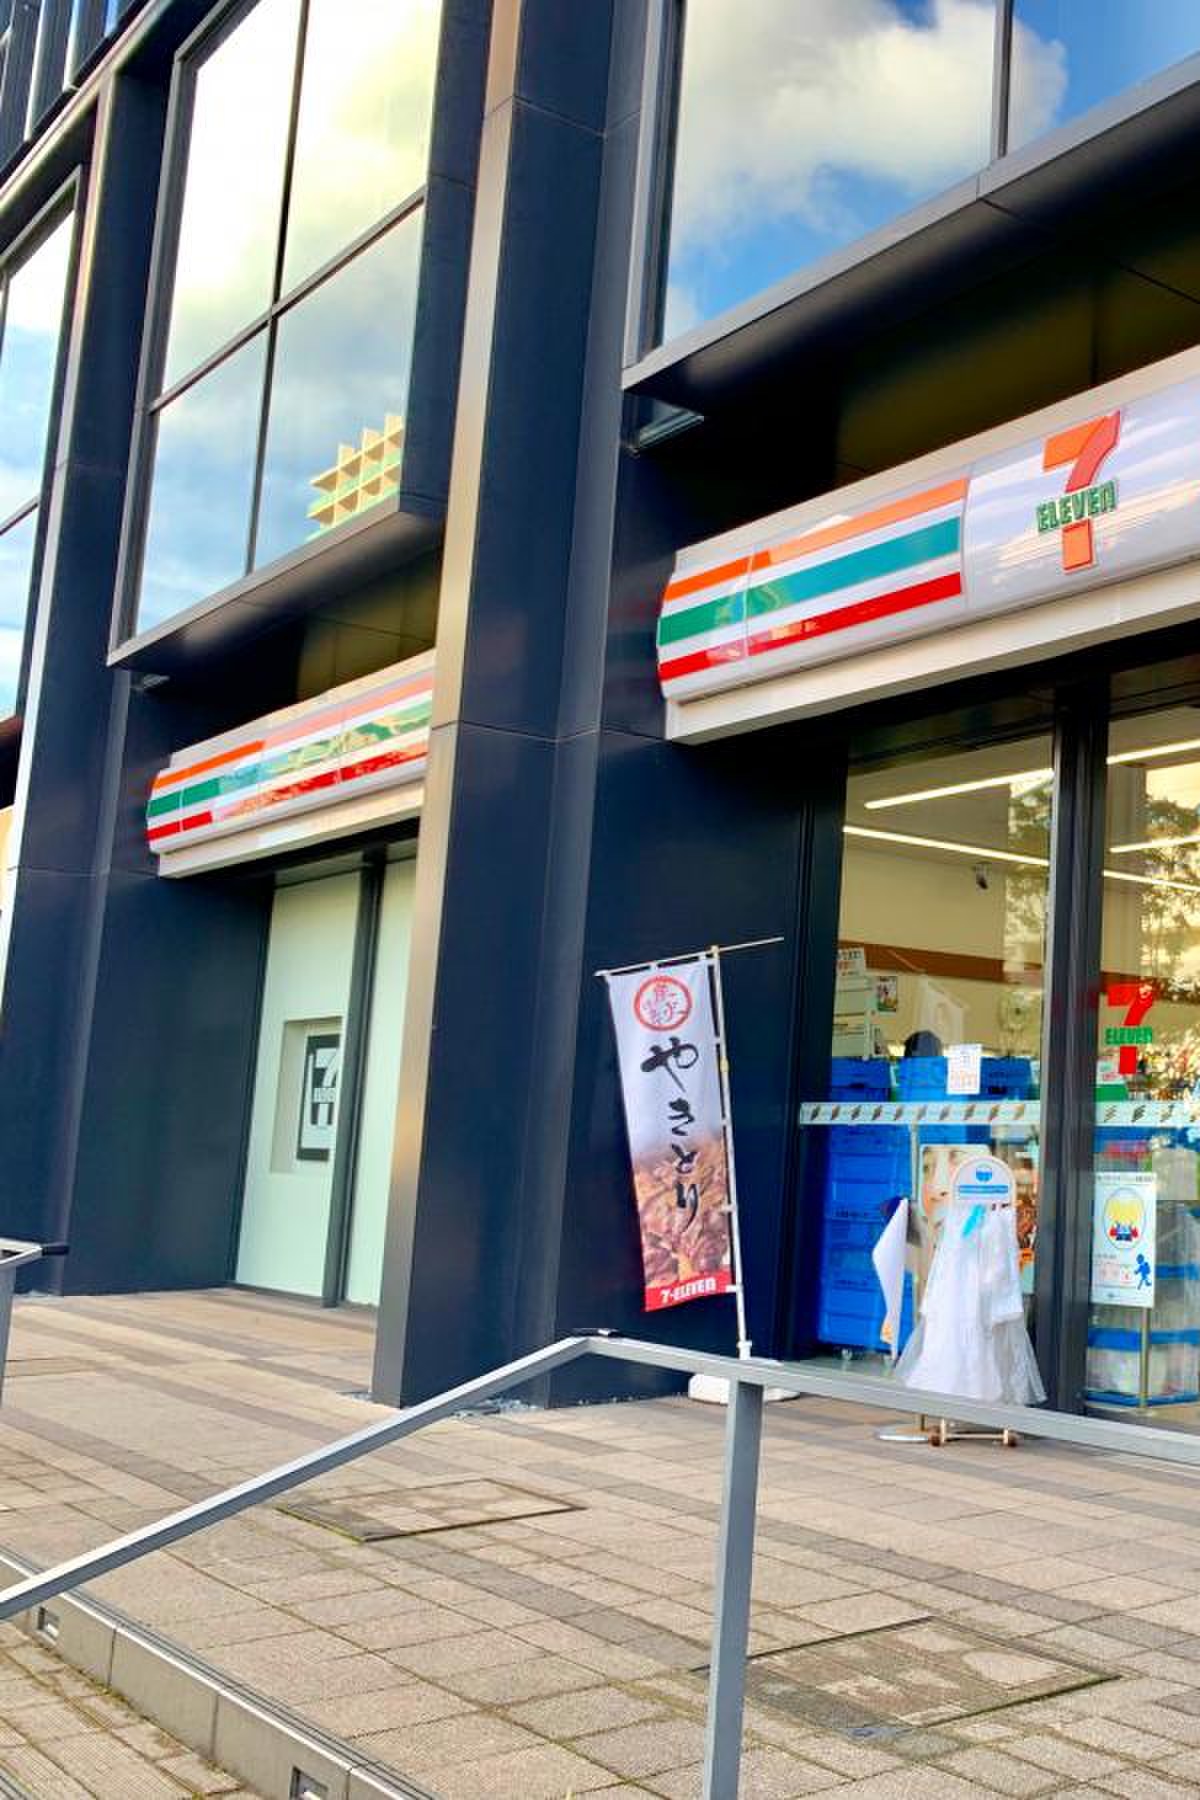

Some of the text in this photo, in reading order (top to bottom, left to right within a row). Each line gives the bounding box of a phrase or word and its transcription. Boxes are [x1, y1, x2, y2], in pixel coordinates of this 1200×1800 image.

[1043, 410, 1120, 572] 7
[641, 1037, 700, 1233] やきとり
